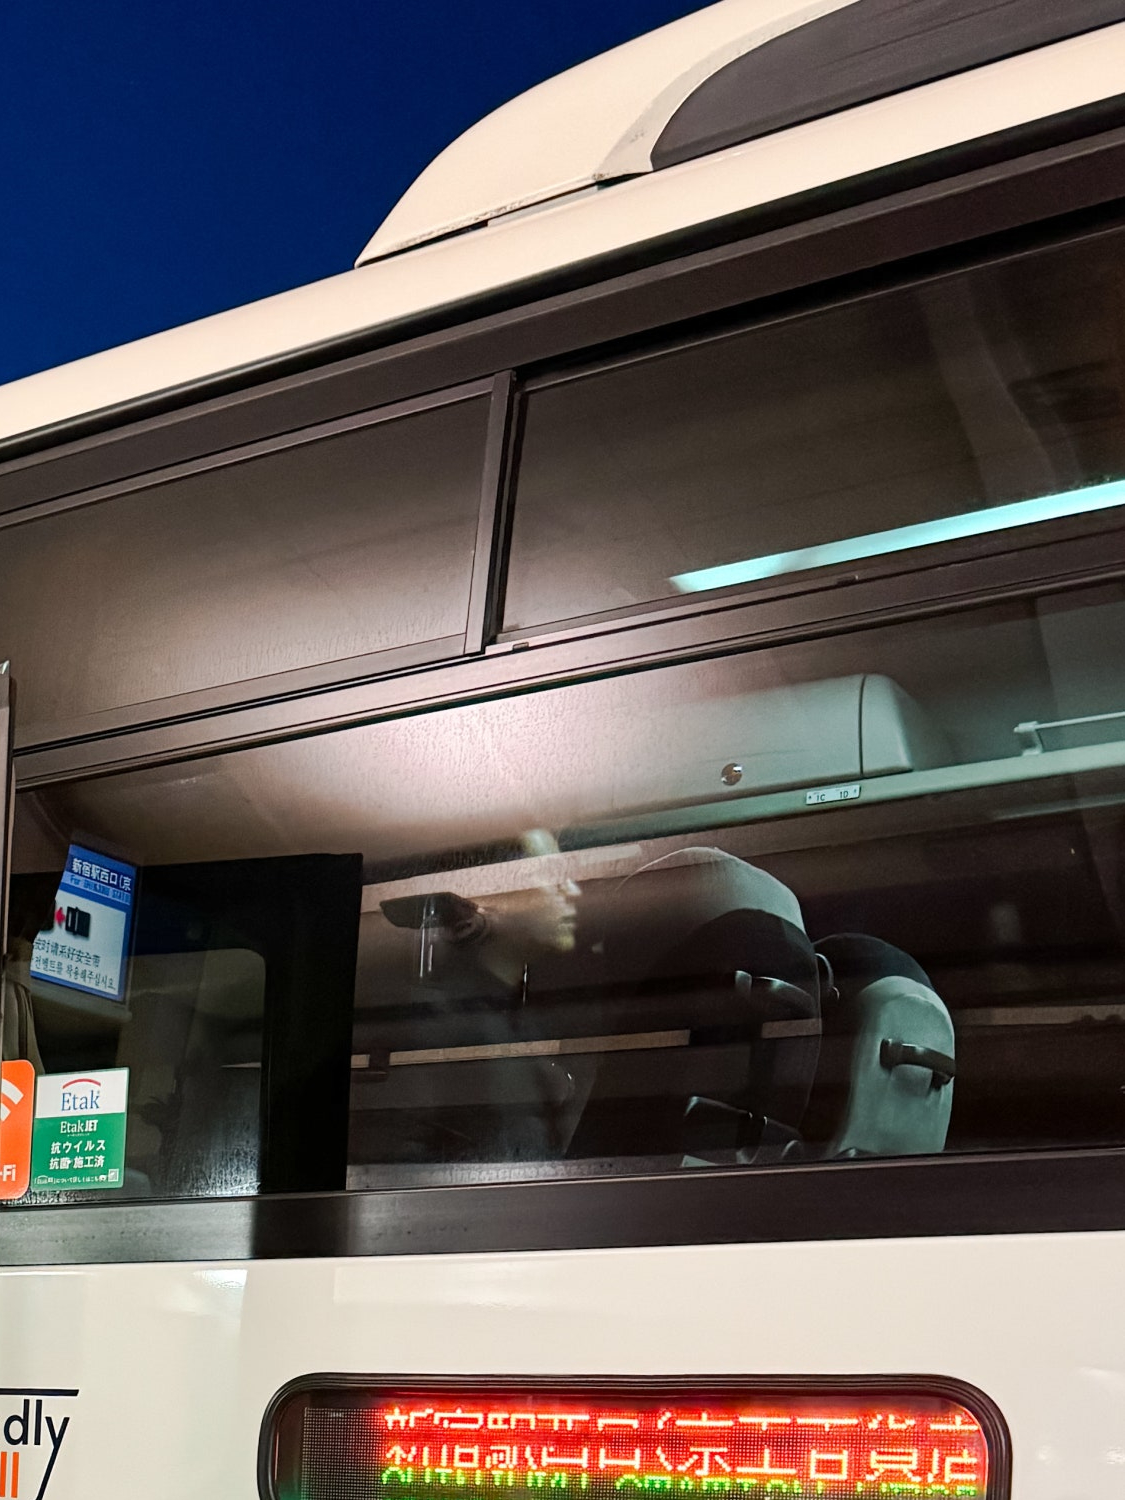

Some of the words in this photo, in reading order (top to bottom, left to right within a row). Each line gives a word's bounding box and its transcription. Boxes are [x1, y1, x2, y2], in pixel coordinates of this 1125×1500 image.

[61, 1089, 100, 1112] Etak
[50, 1139, 106, 1155] 抗ウイルス
